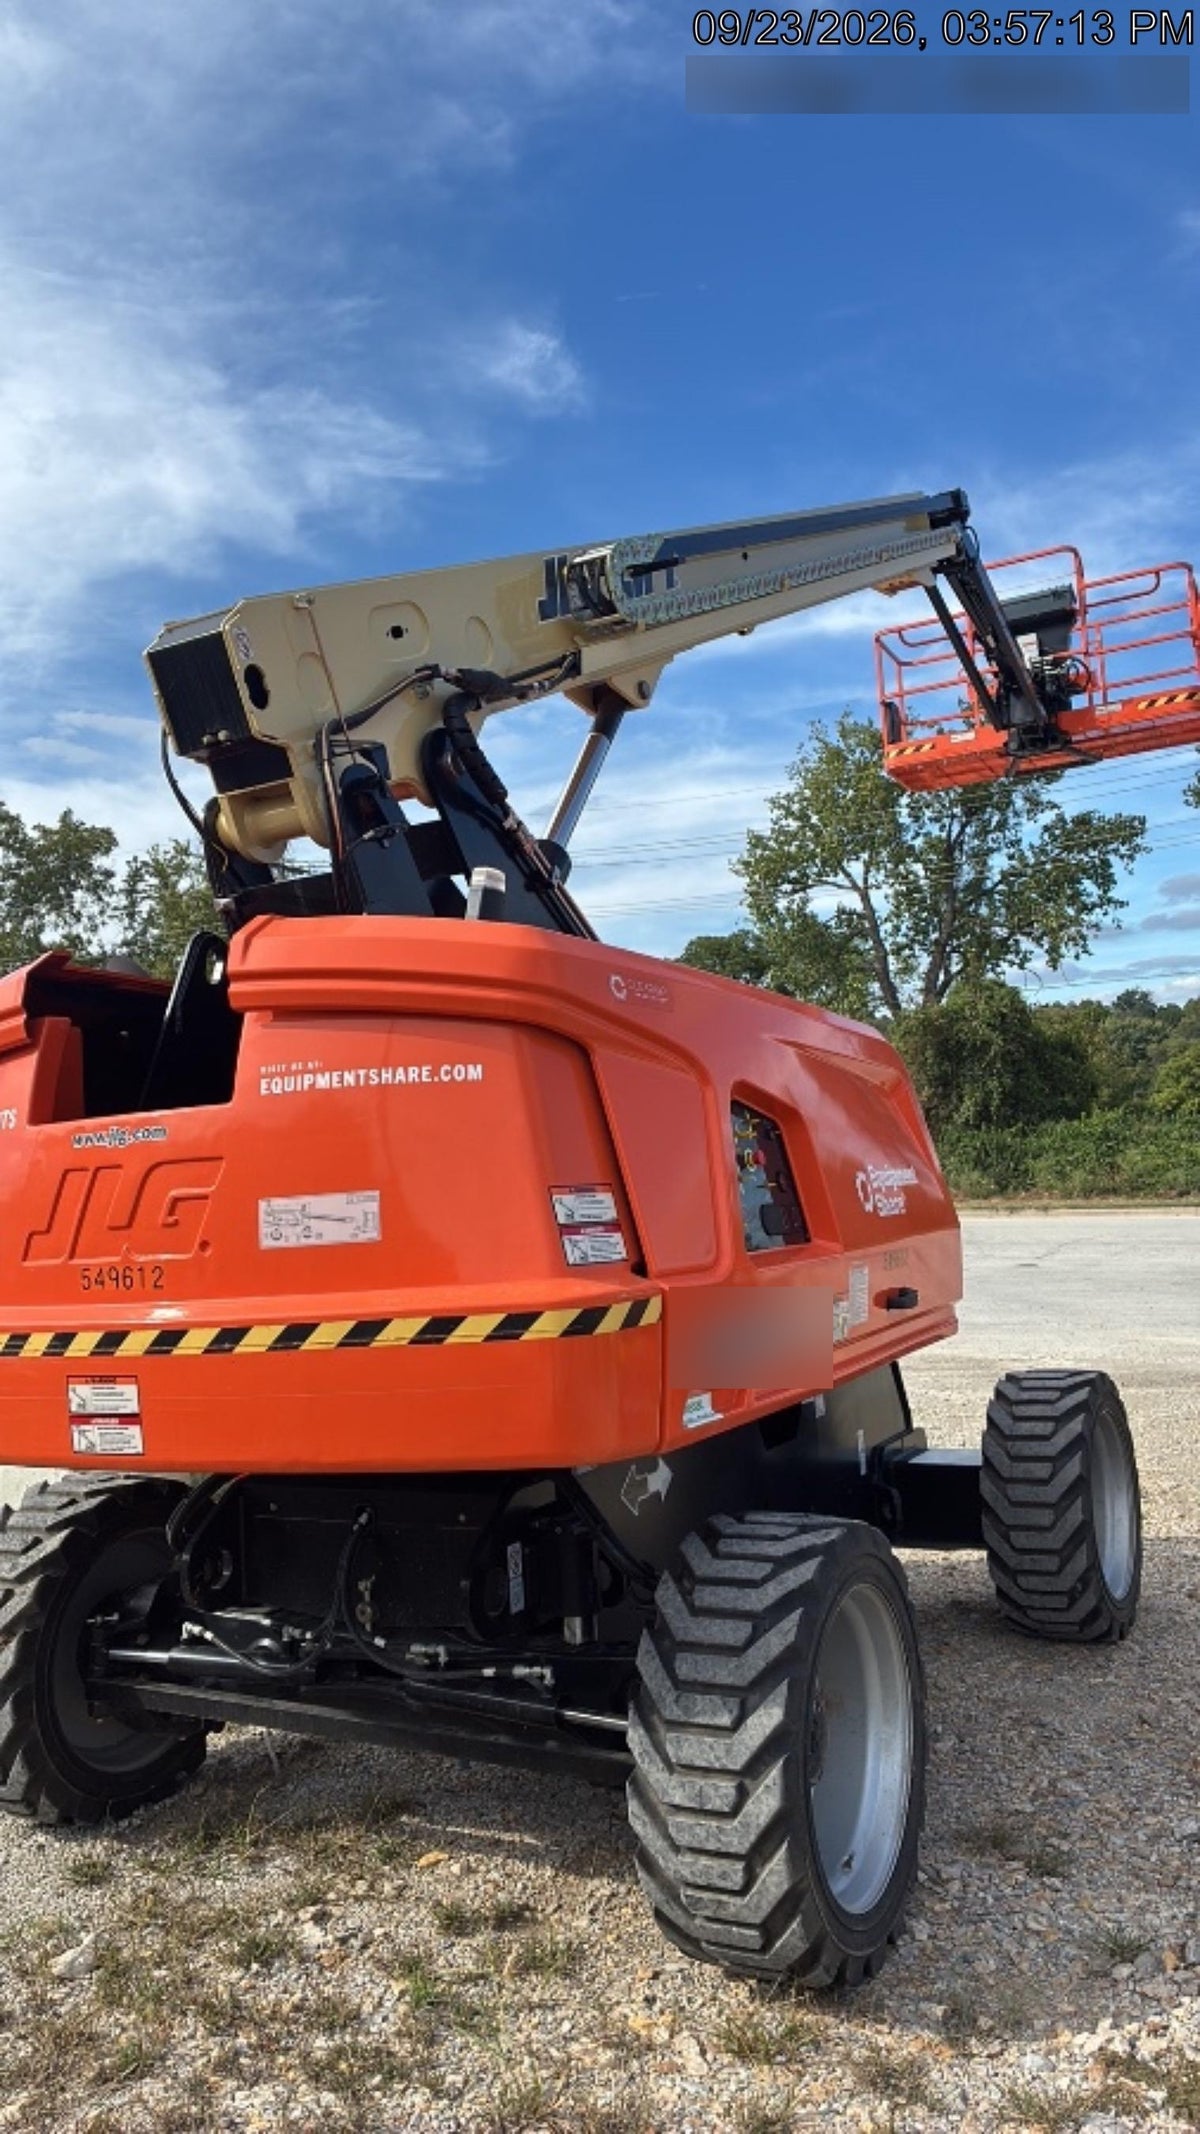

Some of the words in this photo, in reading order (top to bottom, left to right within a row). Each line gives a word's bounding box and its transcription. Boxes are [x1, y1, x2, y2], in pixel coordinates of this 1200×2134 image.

[260, 1064, 483, 1096] EQUIPMENTSHARE.COM
[22, 1156, 226, 1266] JLG
[81, 1266, 165, 1290] 549612
